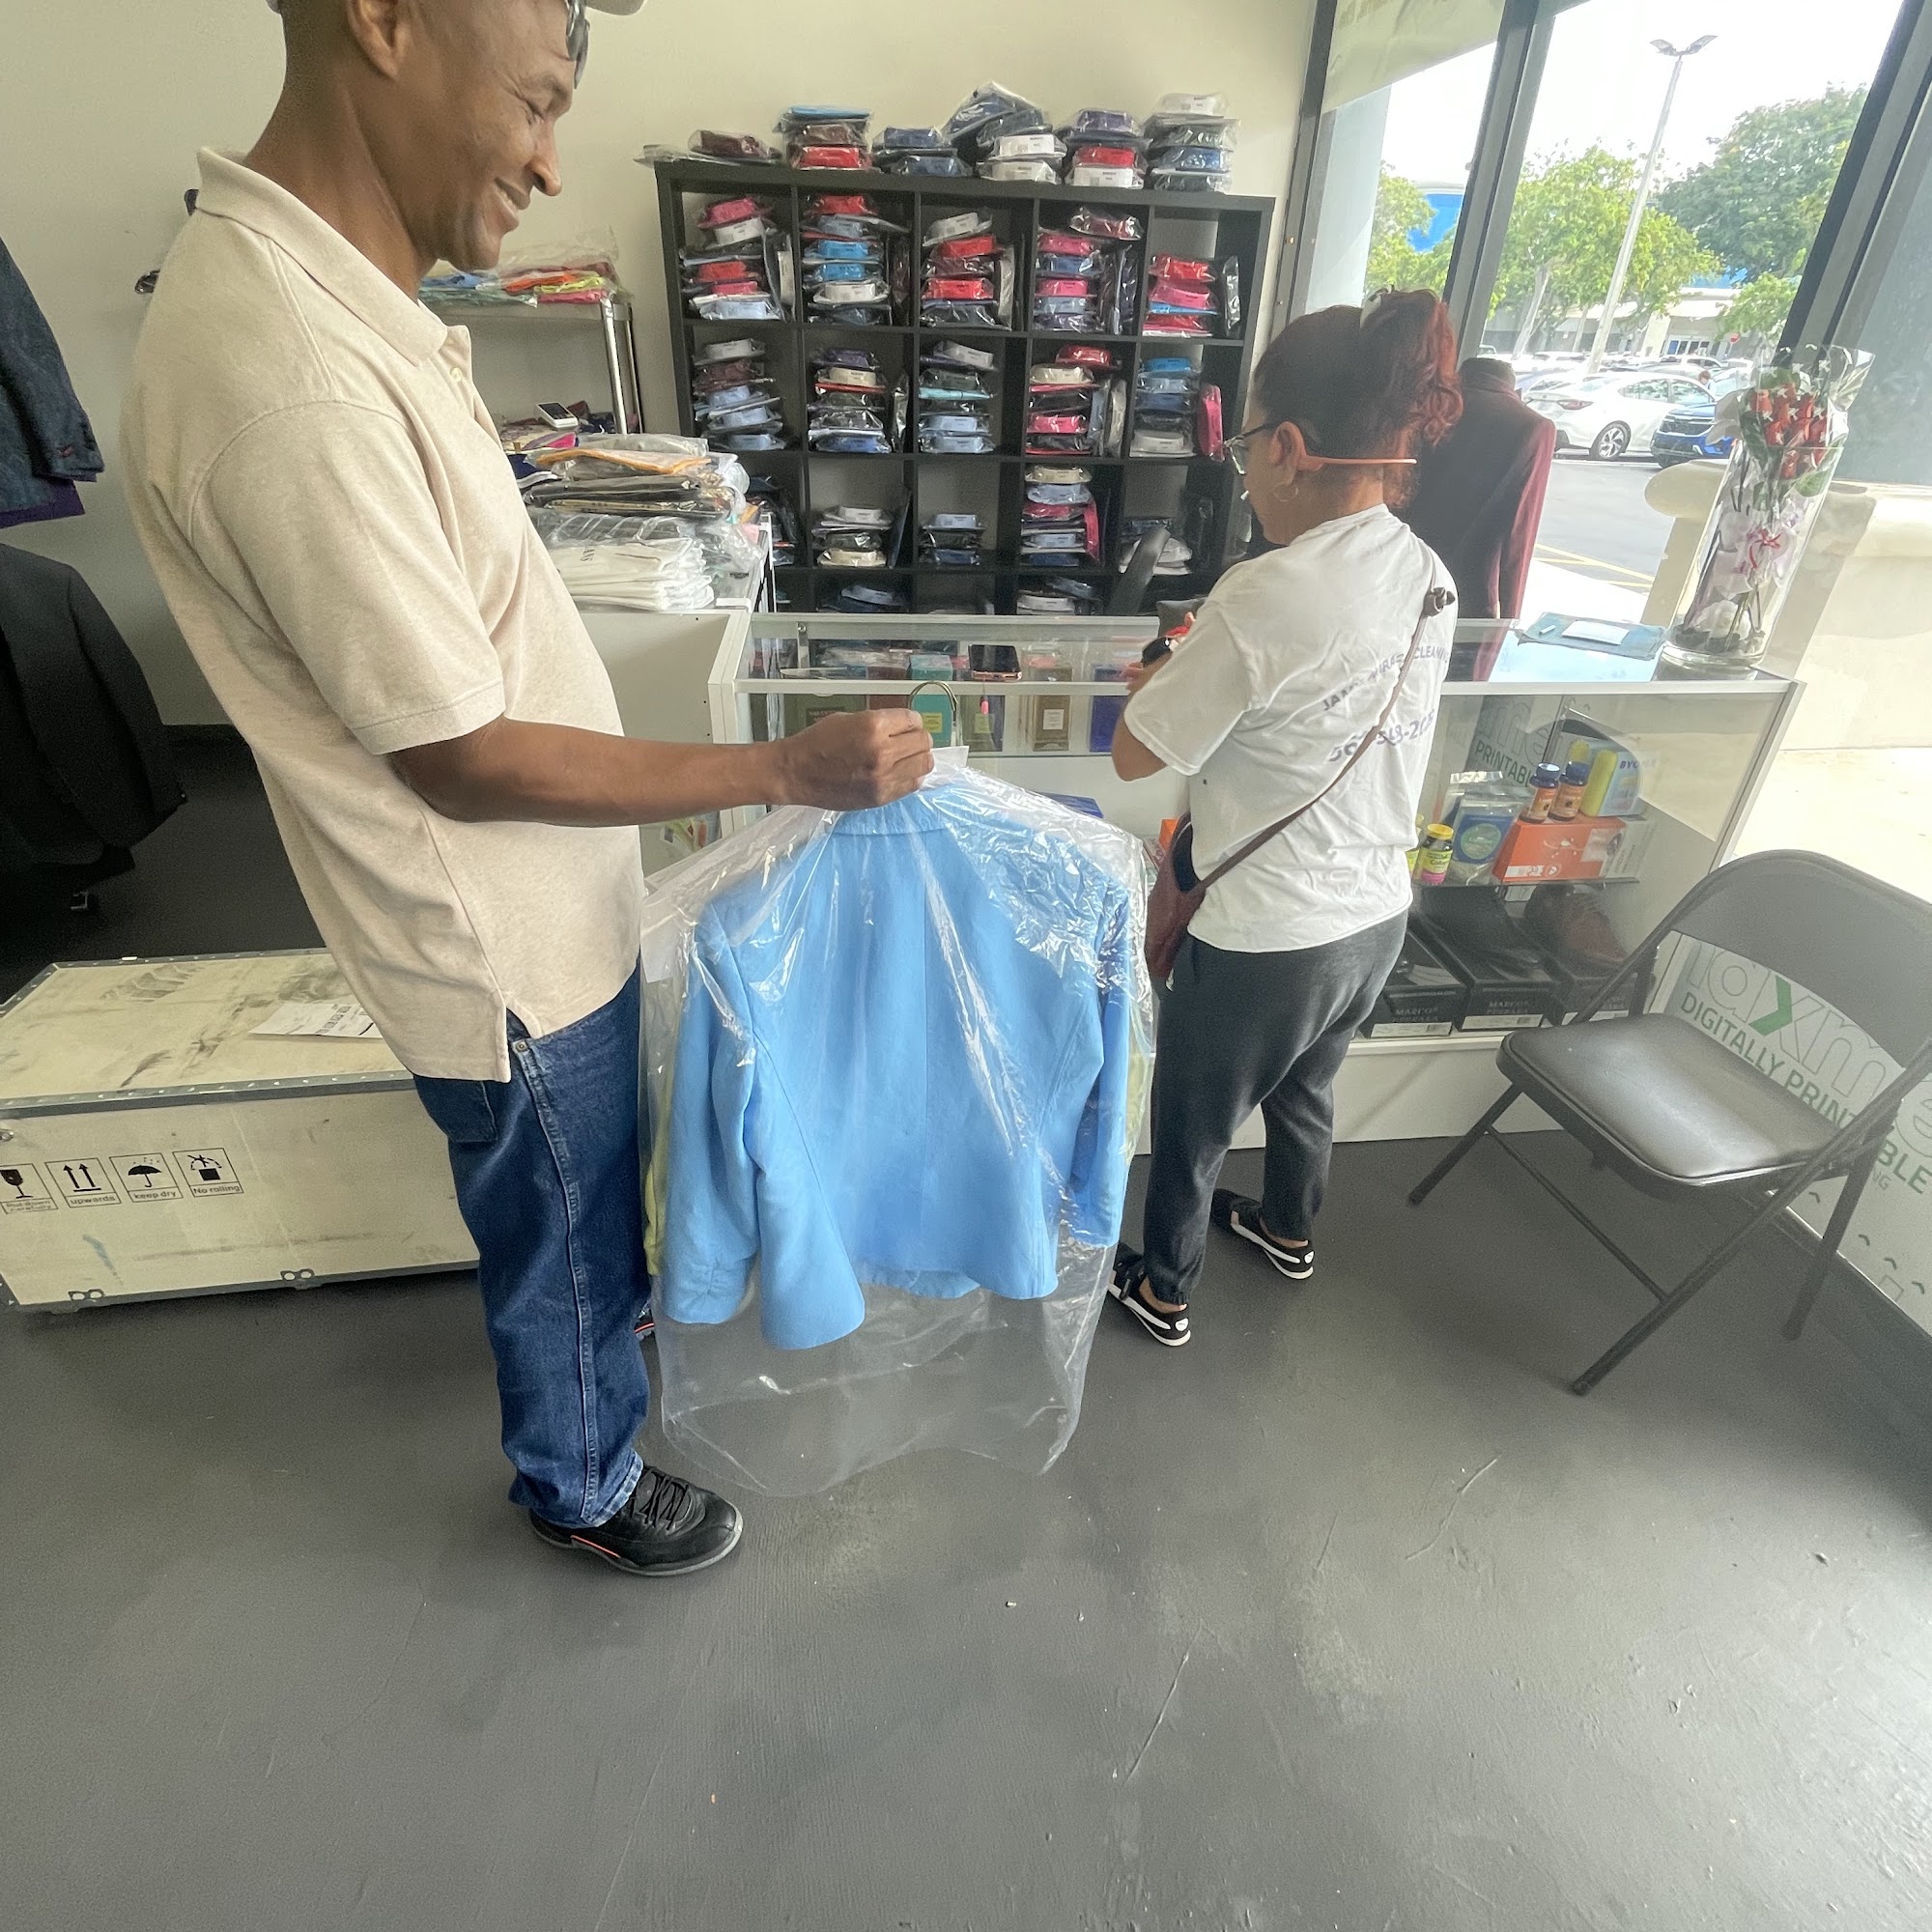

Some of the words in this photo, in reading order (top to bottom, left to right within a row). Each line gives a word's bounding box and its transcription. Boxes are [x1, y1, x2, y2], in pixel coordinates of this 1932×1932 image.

[1475, 739, 1531, 787] PRINTABL
[1680, 992, 1785, 1078] DIGITALLY
[209, 1184, 241, 1193] rolling
[71, 1195, 116, 1205] upwards
[133, 1191, 159, 1201] keep
[160, 1189, 177, 1200] dry
